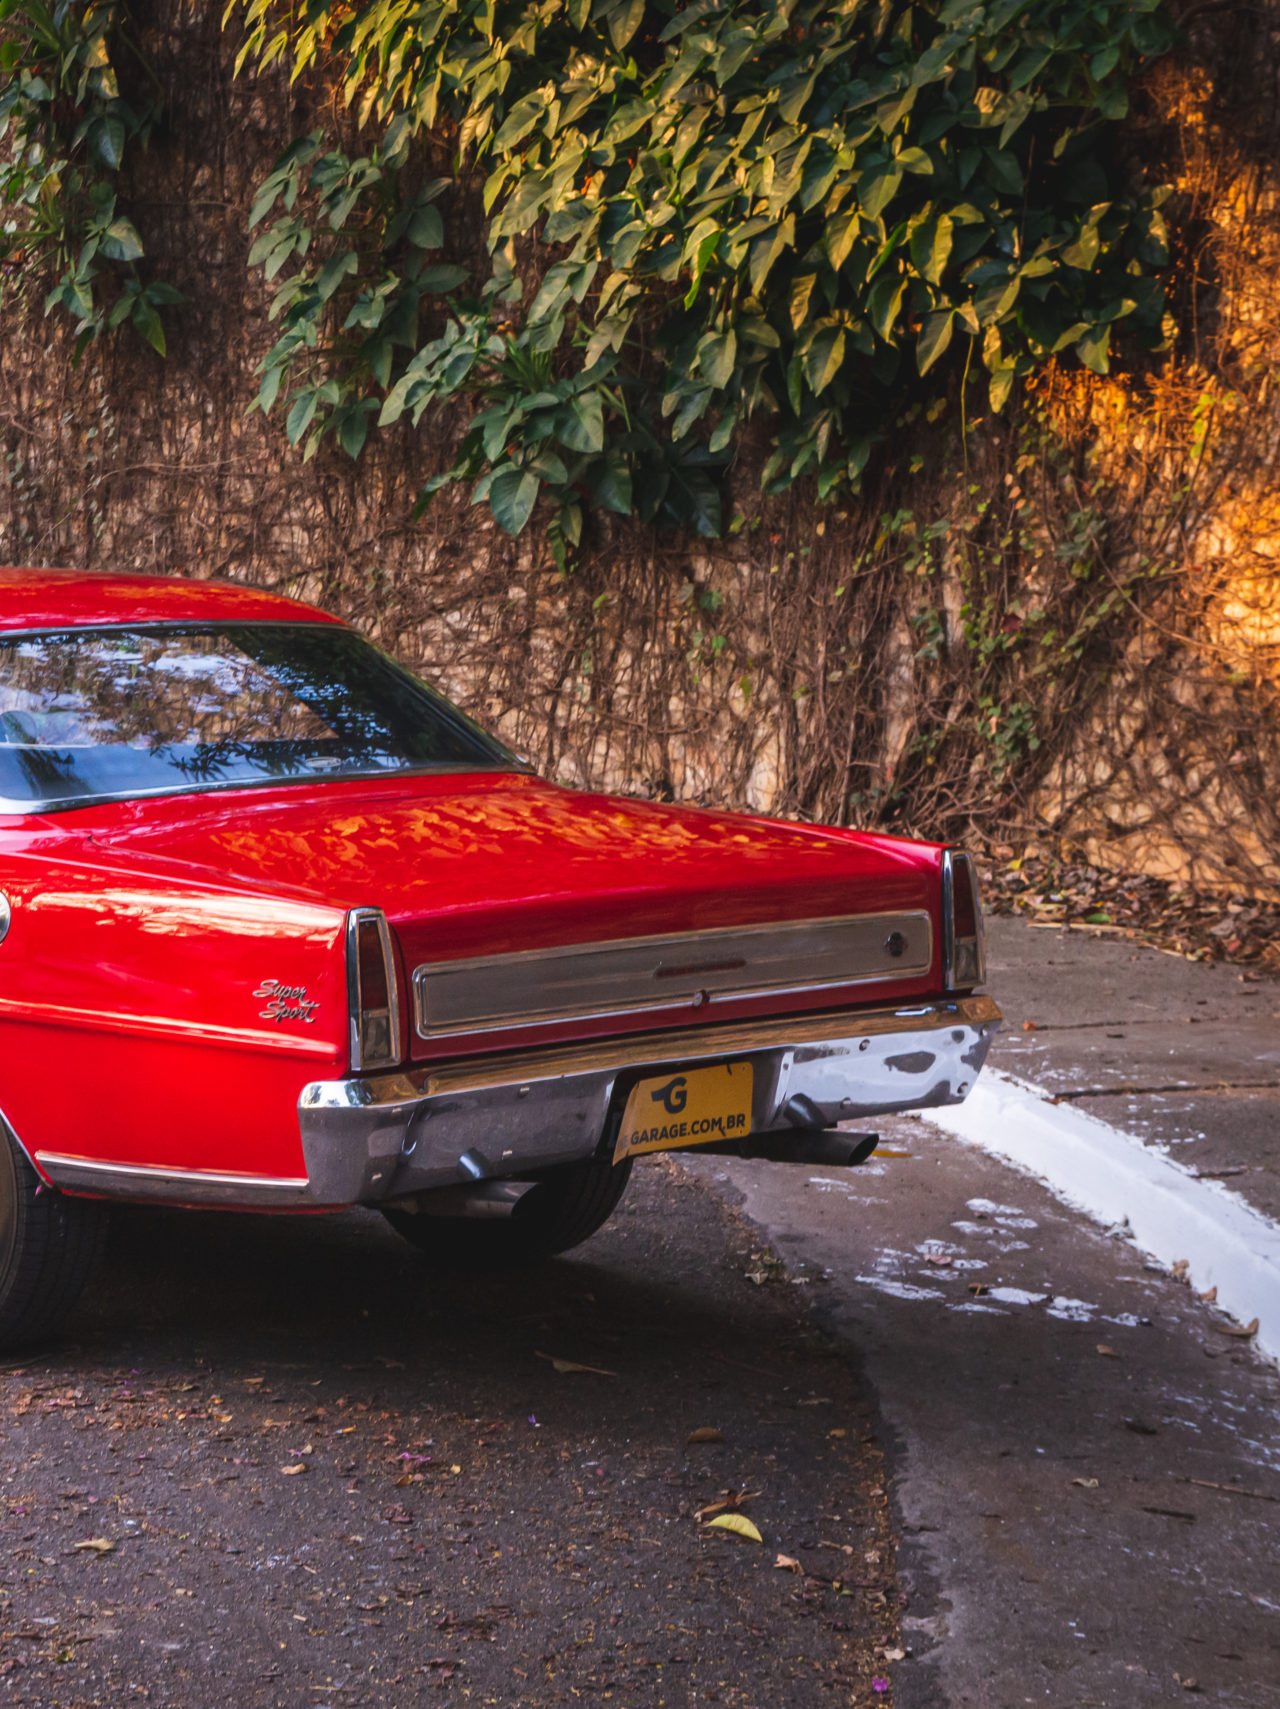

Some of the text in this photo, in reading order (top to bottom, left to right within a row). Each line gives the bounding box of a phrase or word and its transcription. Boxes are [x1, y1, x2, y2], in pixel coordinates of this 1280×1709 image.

[252, 979, 306, 1004] Super
[258, 1001, 320, 1023] Sport
[631, 1114, 745, 1145] GARAGE.COM.BR
